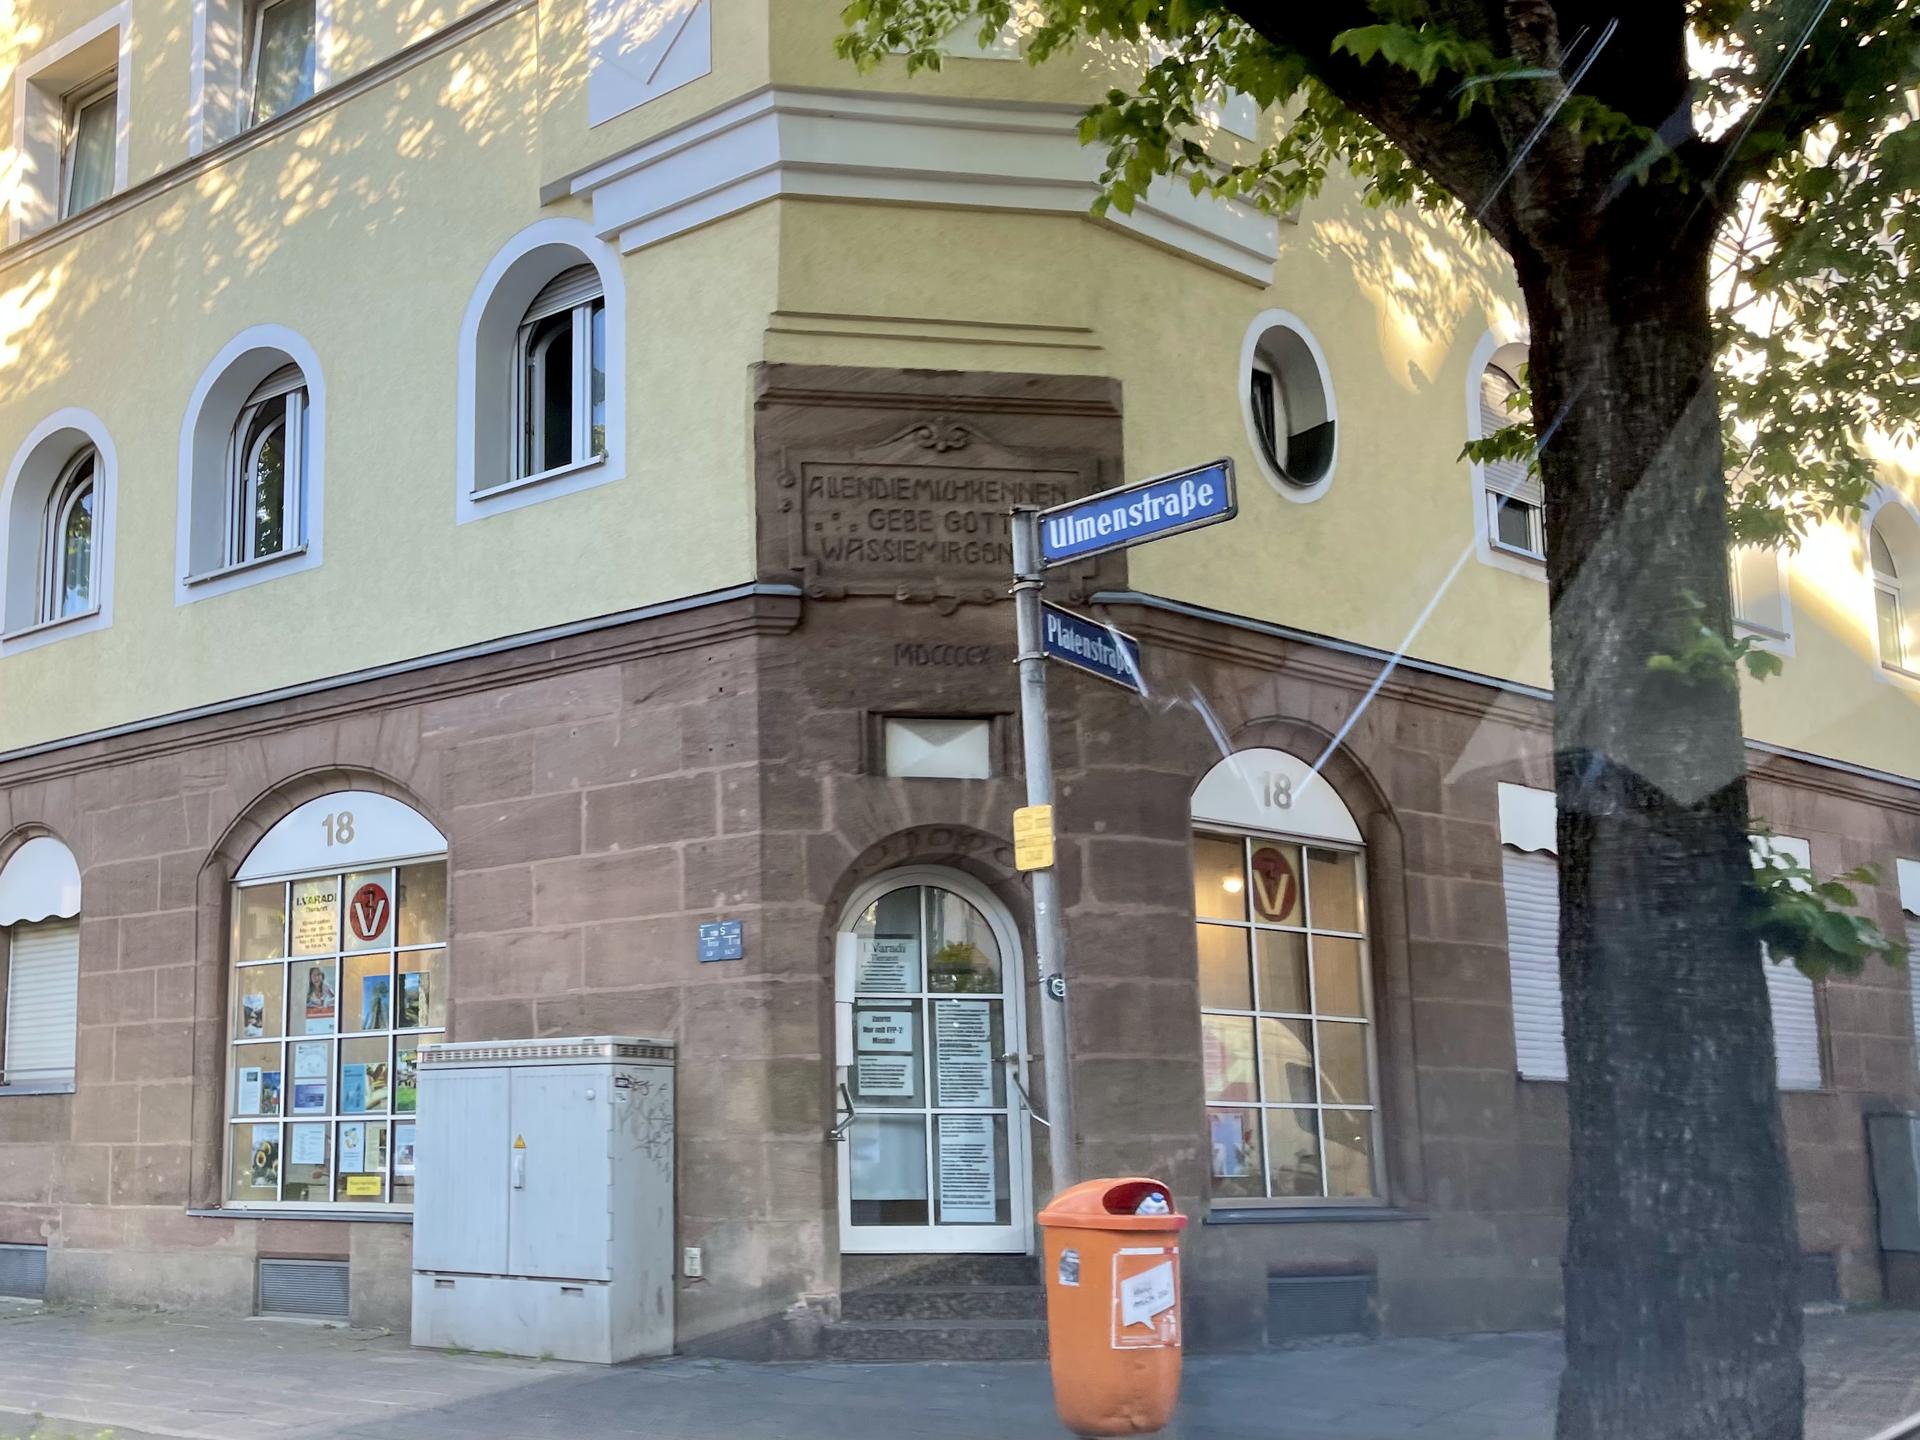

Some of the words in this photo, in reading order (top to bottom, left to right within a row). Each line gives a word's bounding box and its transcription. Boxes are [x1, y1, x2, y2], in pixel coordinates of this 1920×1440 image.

[867, 508, 934, 533] GEBE
[944, 510, 1011, 535] GOTT
[1050, 480, 1214, 549] Ulmenstraße
[1259, 770, 1292, 810] 18
[322, 811, 354, 847] 18
[354, 900, 385, 936] V
